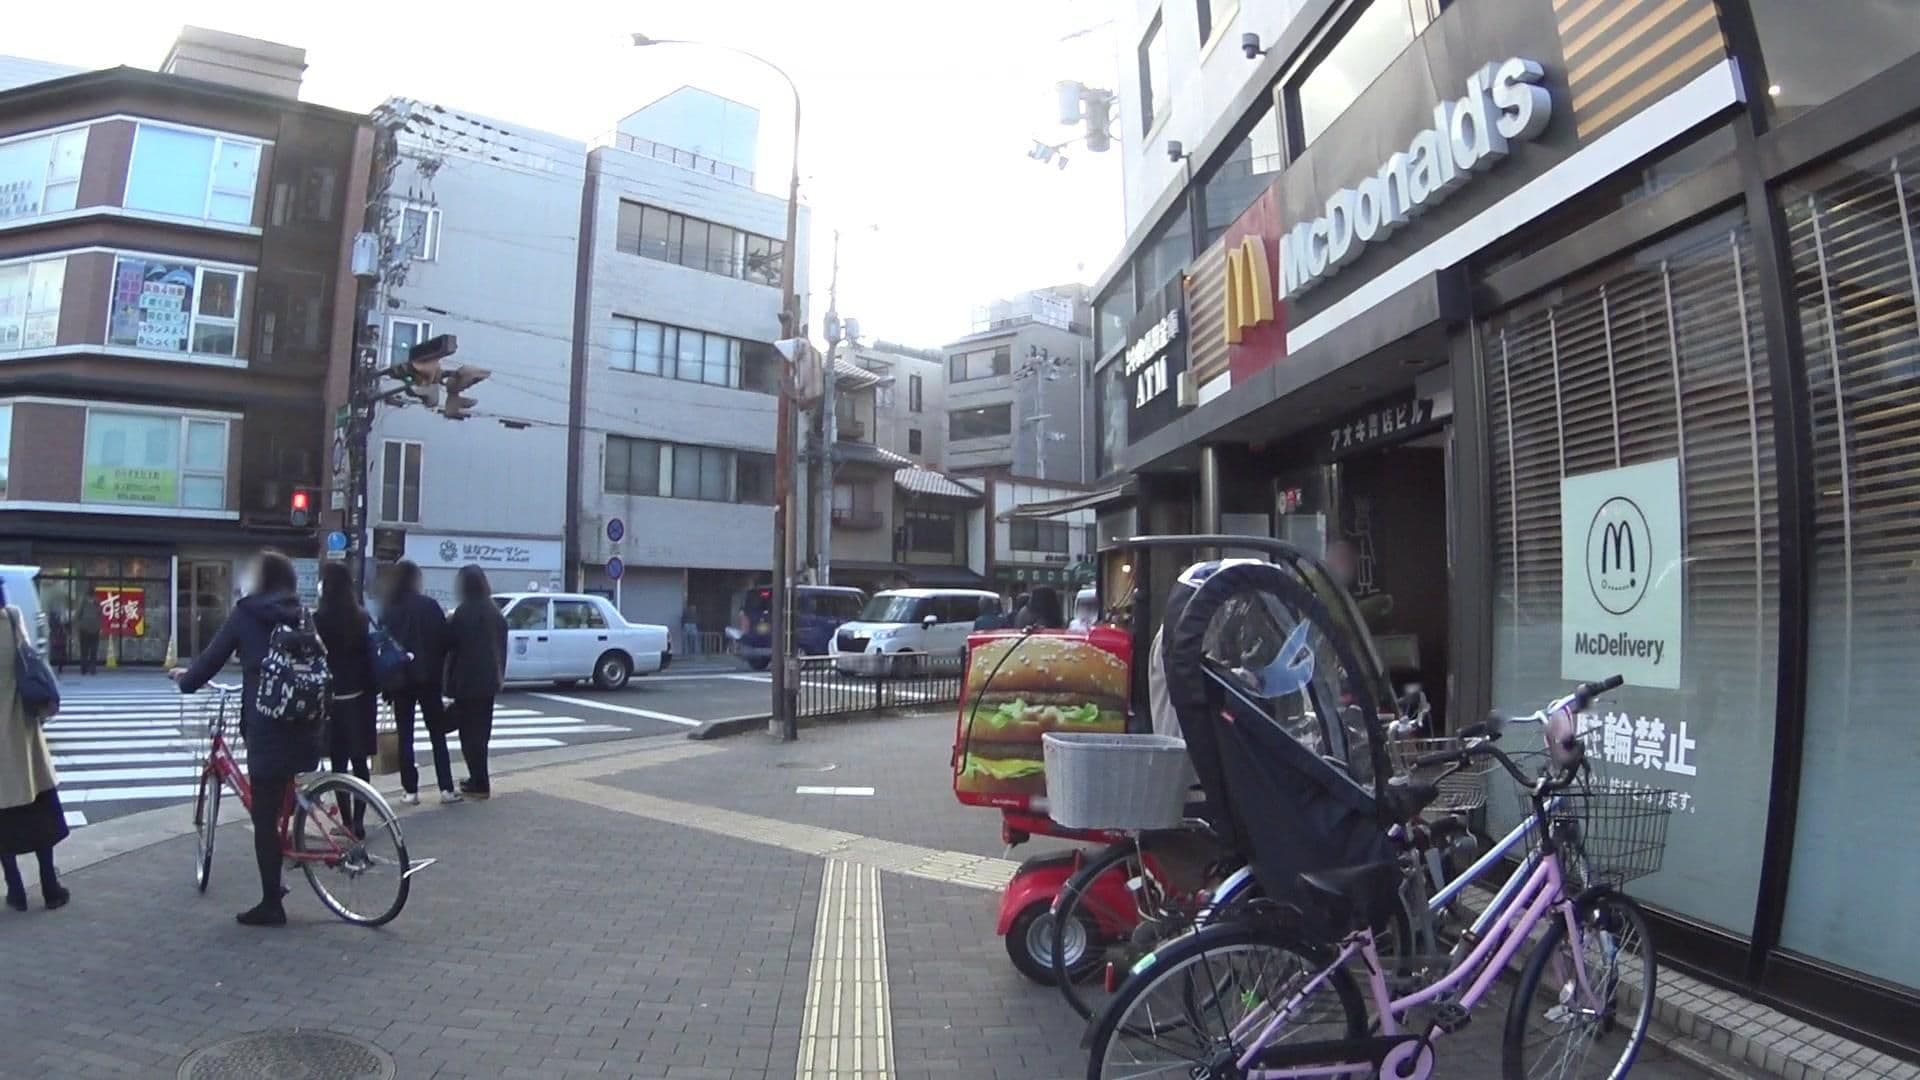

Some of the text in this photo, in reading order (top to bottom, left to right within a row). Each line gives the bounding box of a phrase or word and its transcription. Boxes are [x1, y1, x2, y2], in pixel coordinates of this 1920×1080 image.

[1279, 55, 1552, 302] McDonald's
[1136, 355, 1169, 409] ATM
[462, 543, 530, 556] はなファーマシー
[1574, 631, 1665, 665] McDelivery
